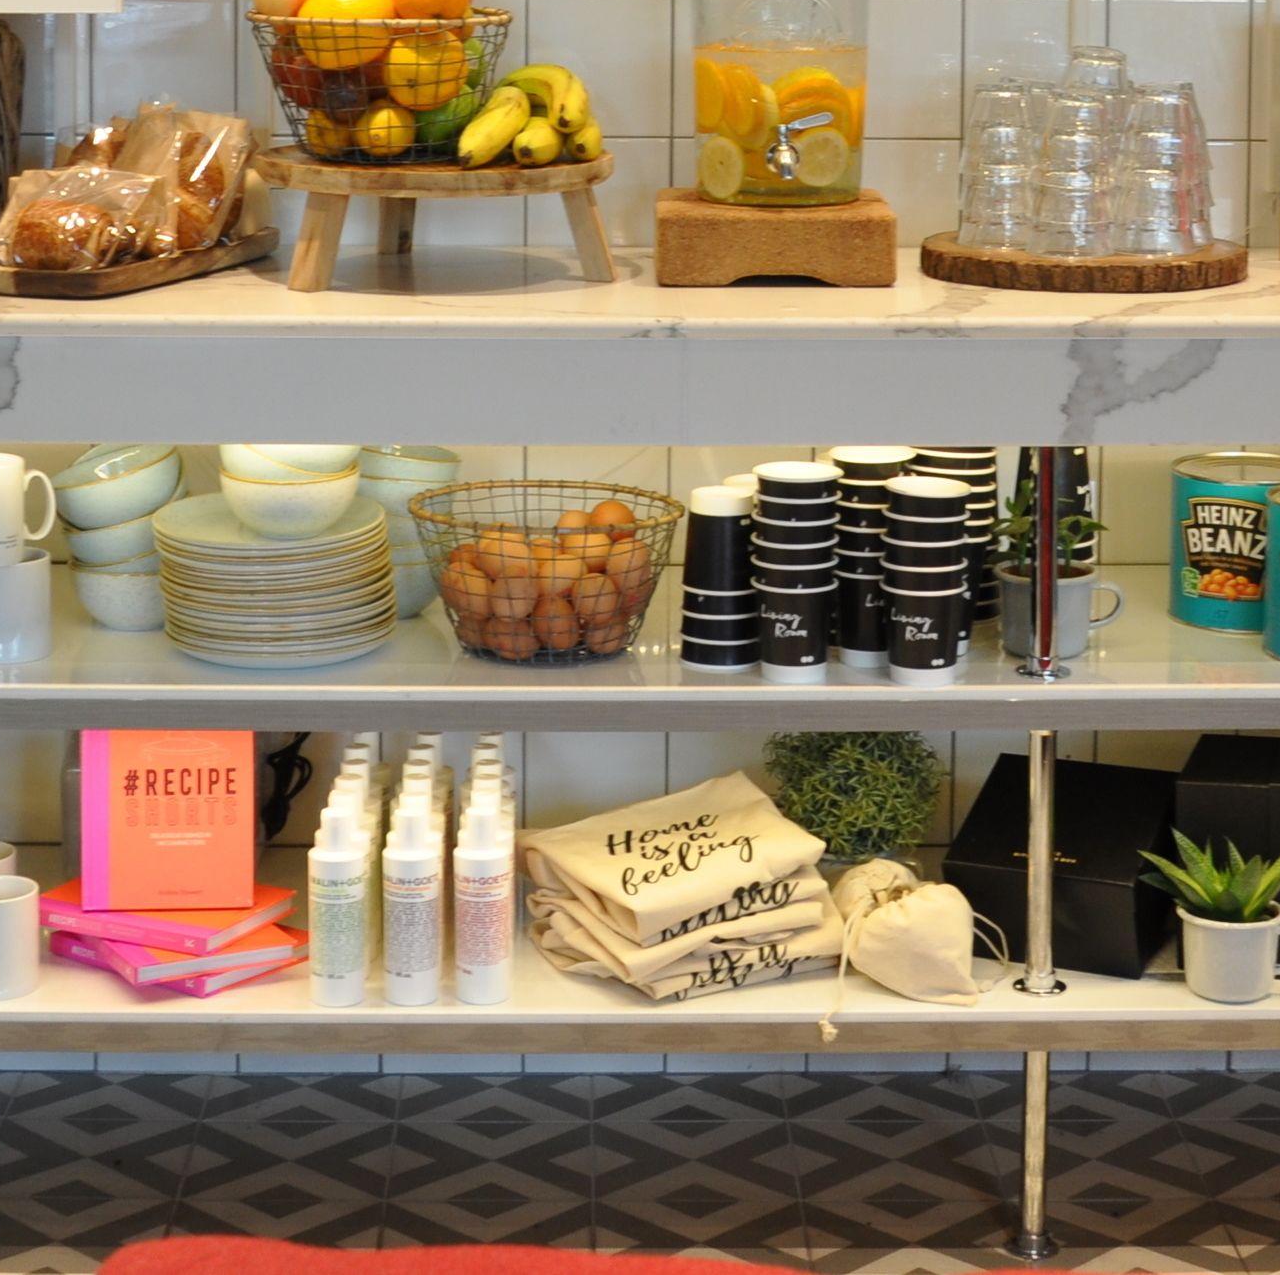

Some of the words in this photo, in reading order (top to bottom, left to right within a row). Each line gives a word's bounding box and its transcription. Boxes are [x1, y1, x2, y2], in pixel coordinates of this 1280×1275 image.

[1196, 505, 1257, 529] HEINZ
[1187, 528, 1267, 560] BEANZ
[123, 767, 237, 797] #RECIPE
[607, 814, 720, 856] Home
[640, 843, 671, 861] is
[688, 829, 717, 843] a
[621, 832, 762, 896] feeling
